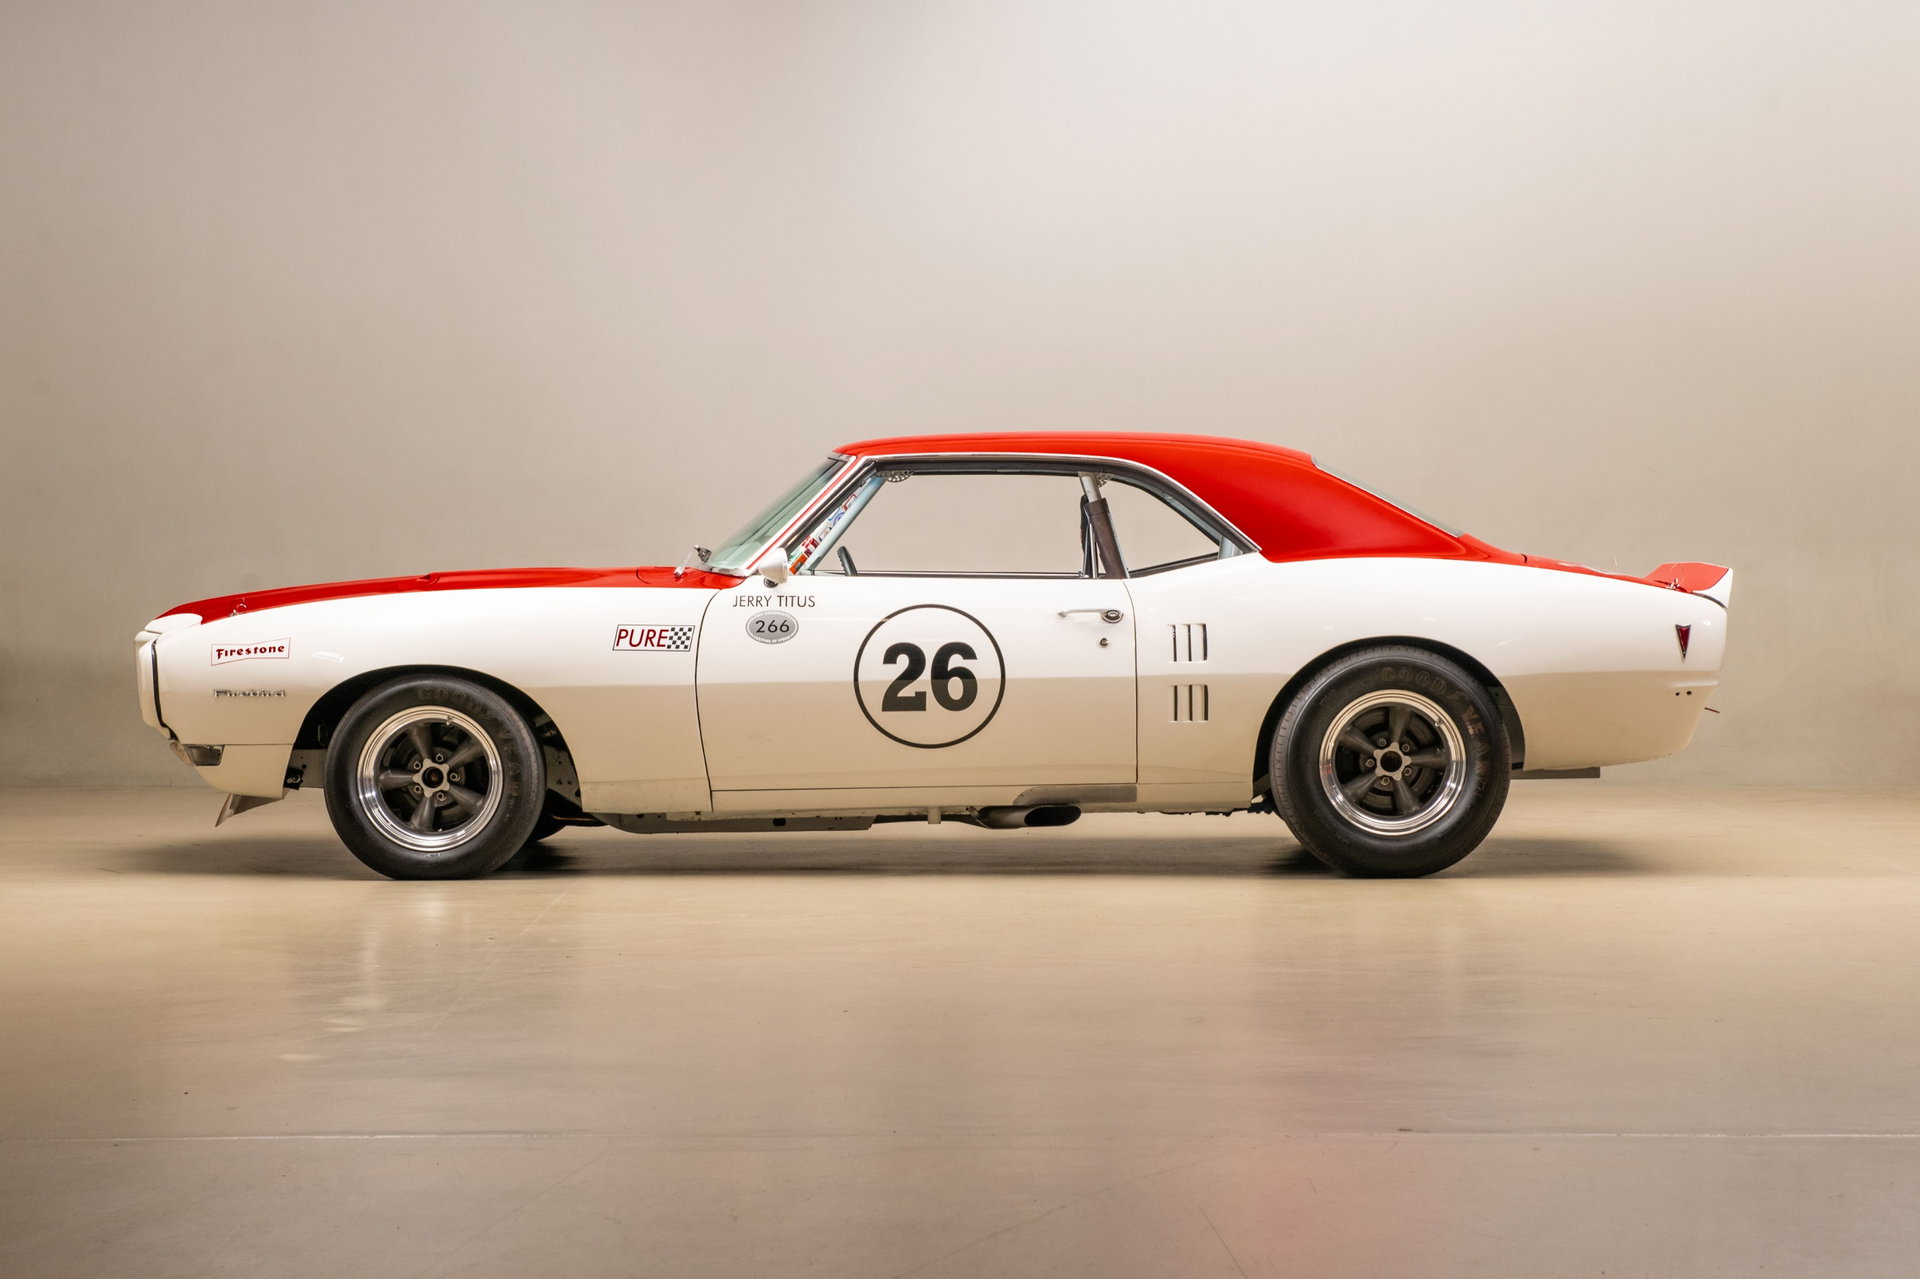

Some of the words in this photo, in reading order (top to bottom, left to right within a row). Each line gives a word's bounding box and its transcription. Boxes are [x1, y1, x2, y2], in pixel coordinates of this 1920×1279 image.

[733, 595, 772, 607] JERRY
[777, 595, 816, 607] TITUS
[755, 620, 790, 633] 266
[616, 629, 669, 648] PURE
[216, 645, 285, 660] Firestone
[882, 642, 978, 712] 26
